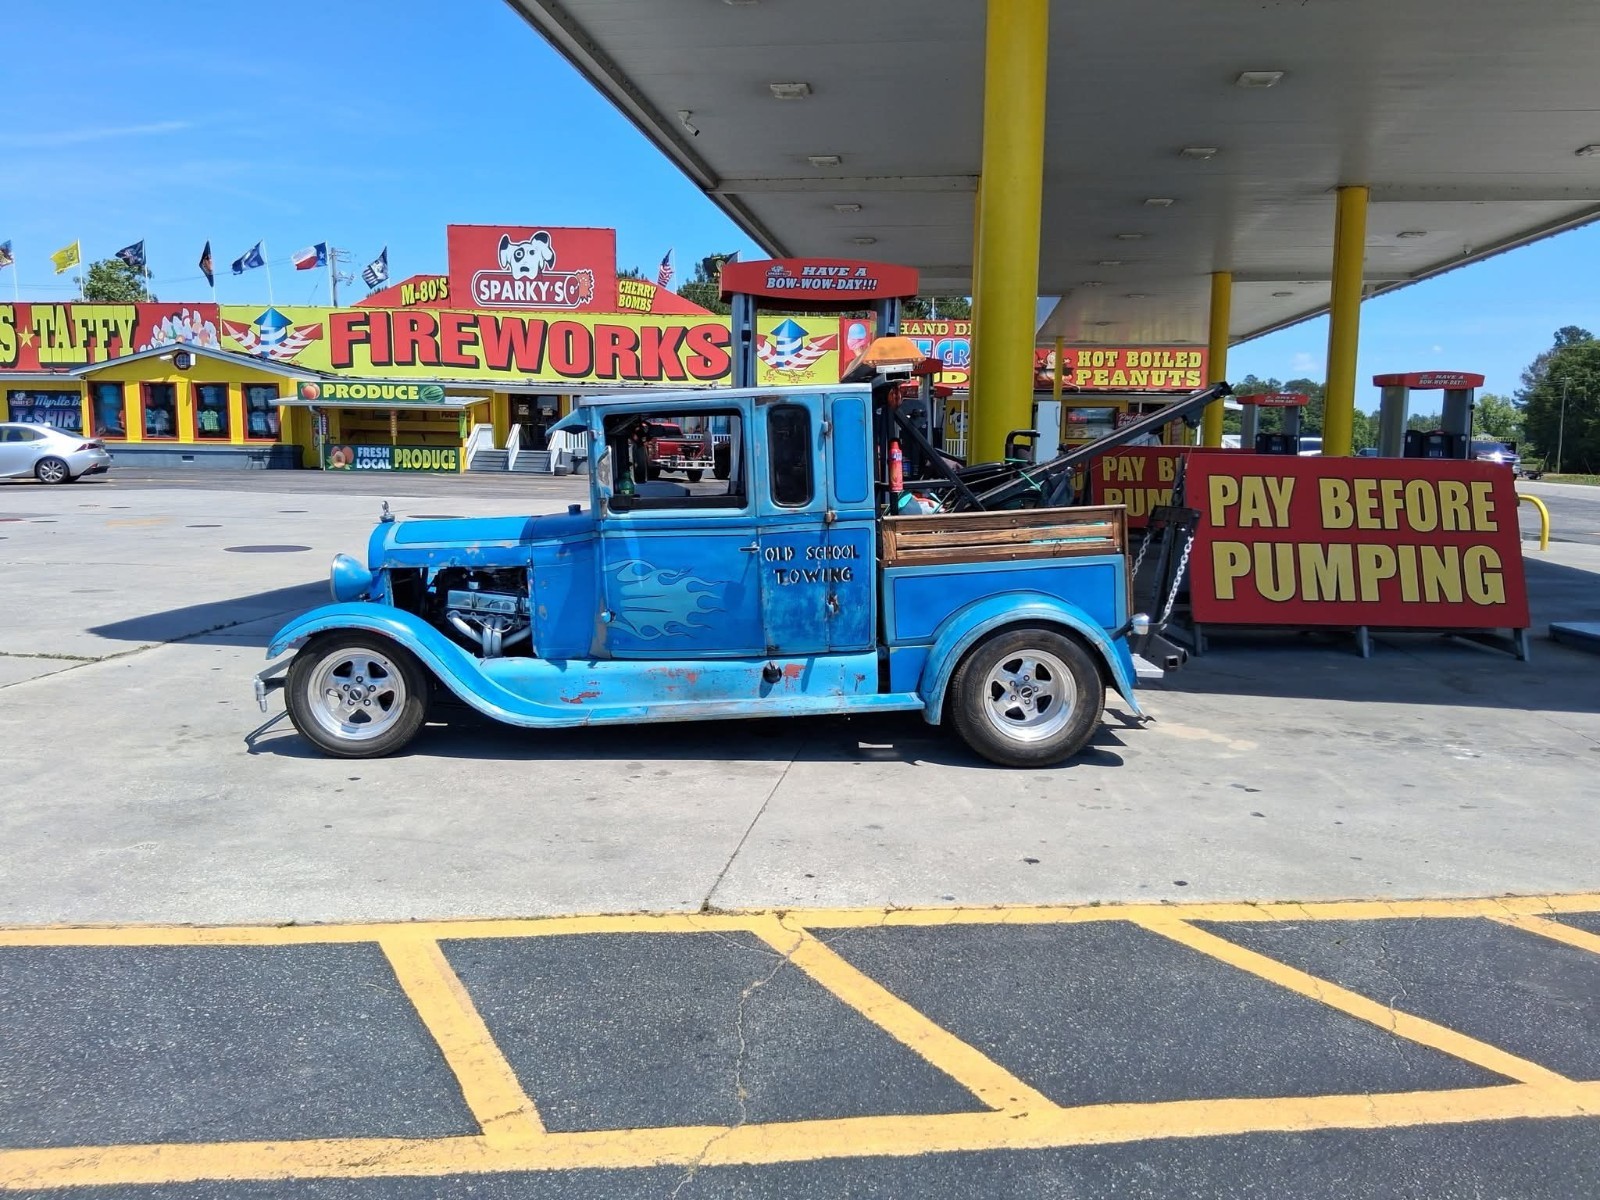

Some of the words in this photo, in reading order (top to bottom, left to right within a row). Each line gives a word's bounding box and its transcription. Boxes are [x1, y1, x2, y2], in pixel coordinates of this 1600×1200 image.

[802, 266, 850, 276] HAVE
[855, 267, 867, 277] A
[401, 277, 448, 305] M-80'S
[479, 279, 564, 302] SPARKY'S
[618, 280, 656, 298] CHERRY
[766, 278, 878, 290] BOW-WOW-DAY!!!
[618, 294, 652, 312] BOMBS
[31, 304, 136, 364] TAFFY
[329, 311, 731, 381] FIREWORKS
[1077, 351, 1118, 368] HOT
[1126, 351, 1202, 369] BOILED
[1076, 369, 1201, 387] PEANUTS
[35, 394, 70, 408] Myrtle
[323, 384, 419, 400] PRODUCE
[357, 447, 390, 458] FRESH
[394, 448, 456, 471] PRODUCE
[356, 458, 391, 470] LOCAL
[1102, 456, 1146, 482] PAY
[1208, 475, 1296, 528] PAY
[1319, 478, 1498, 532] BEFORE
[765, 546, 795, 562] OLD
[806, 544, 859, 560] SCHOOL
[773, 566, 853, 585] TOWING
[1211, 541, 1506, 605] PUMPING
